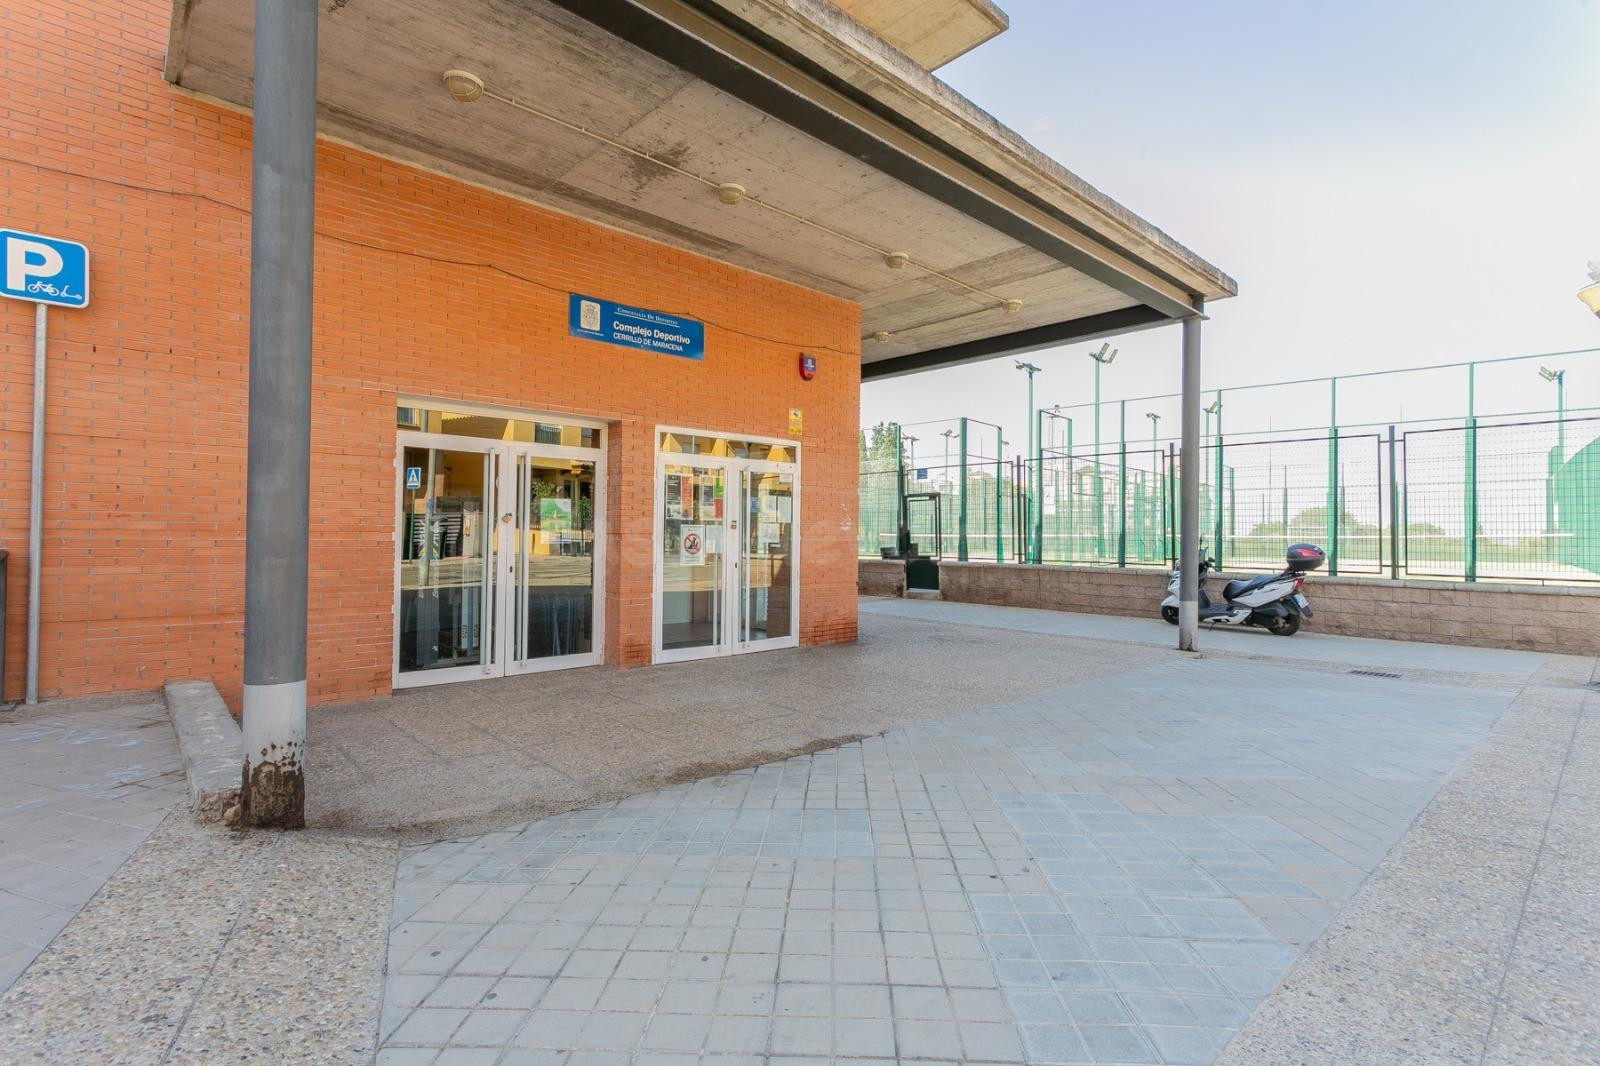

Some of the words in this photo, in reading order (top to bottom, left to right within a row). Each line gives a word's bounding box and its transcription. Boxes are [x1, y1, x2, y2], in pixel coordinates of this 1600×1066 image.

[7, 237, 63, 291] P
[613, 320, 652, 337] Complejo
[653, 329, 691, 345] Deportivo
[613, 332, 643, 344] CERRILLO
[643, 338, 652, 346] DE
[652, 340, 684, 352] MARACENA
